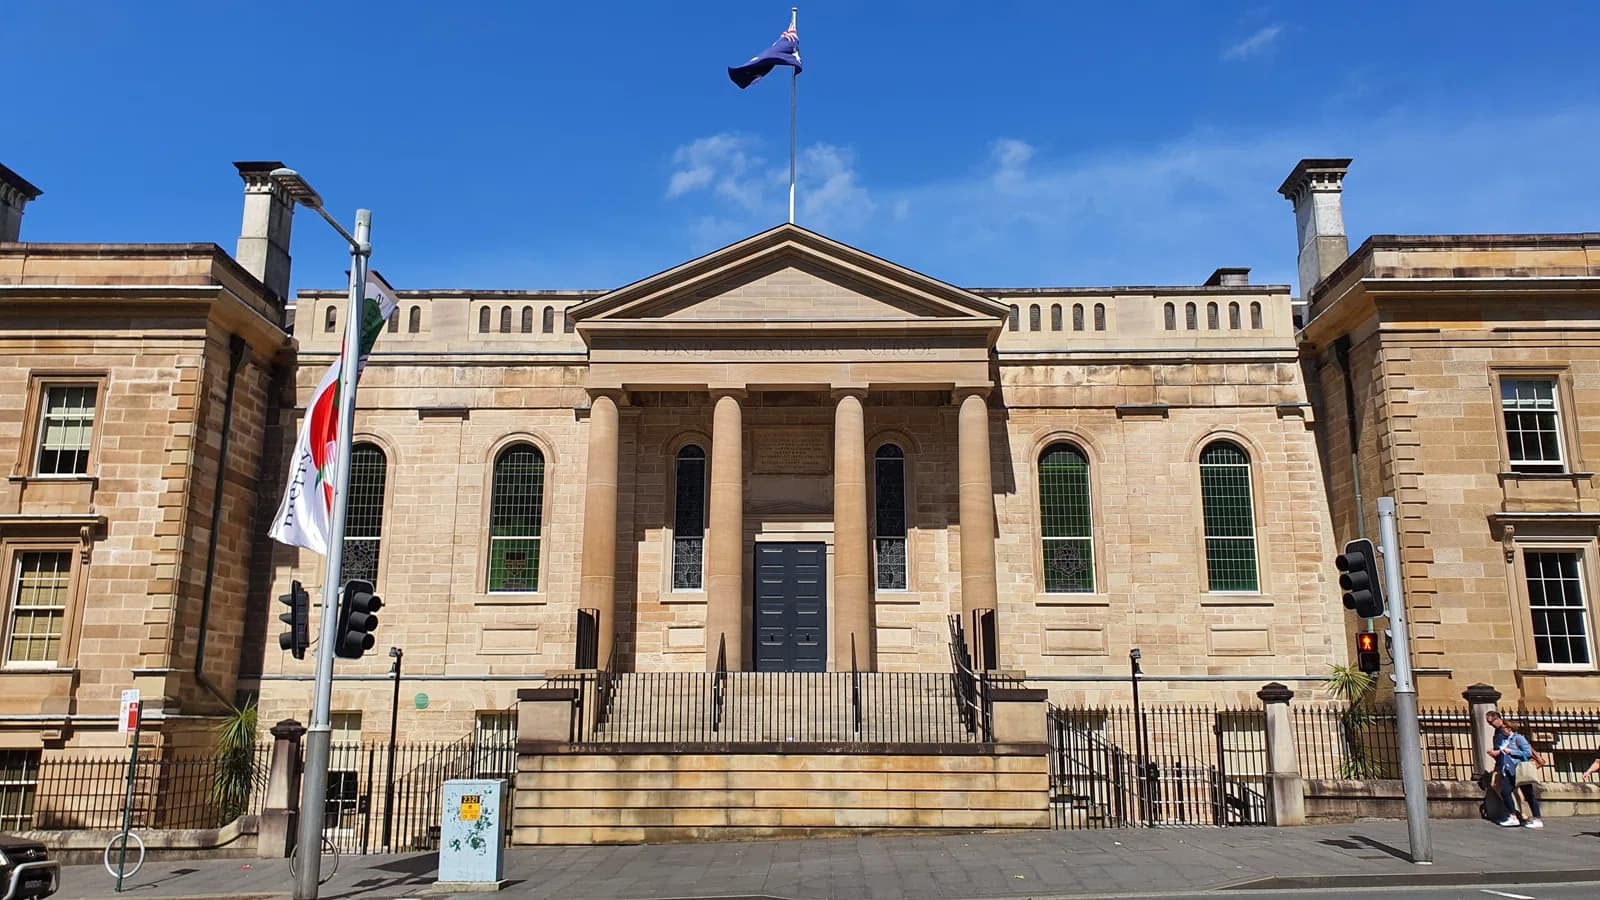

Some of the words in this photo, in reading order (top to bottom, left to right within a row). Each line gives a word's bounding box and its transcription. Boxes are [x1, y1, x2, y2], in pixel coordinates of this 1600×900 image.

[640, 344, 713, 356] SYDNEY
[860, 344, 937, 356] SCHOOL
[283, 446, 312, 527] merry
